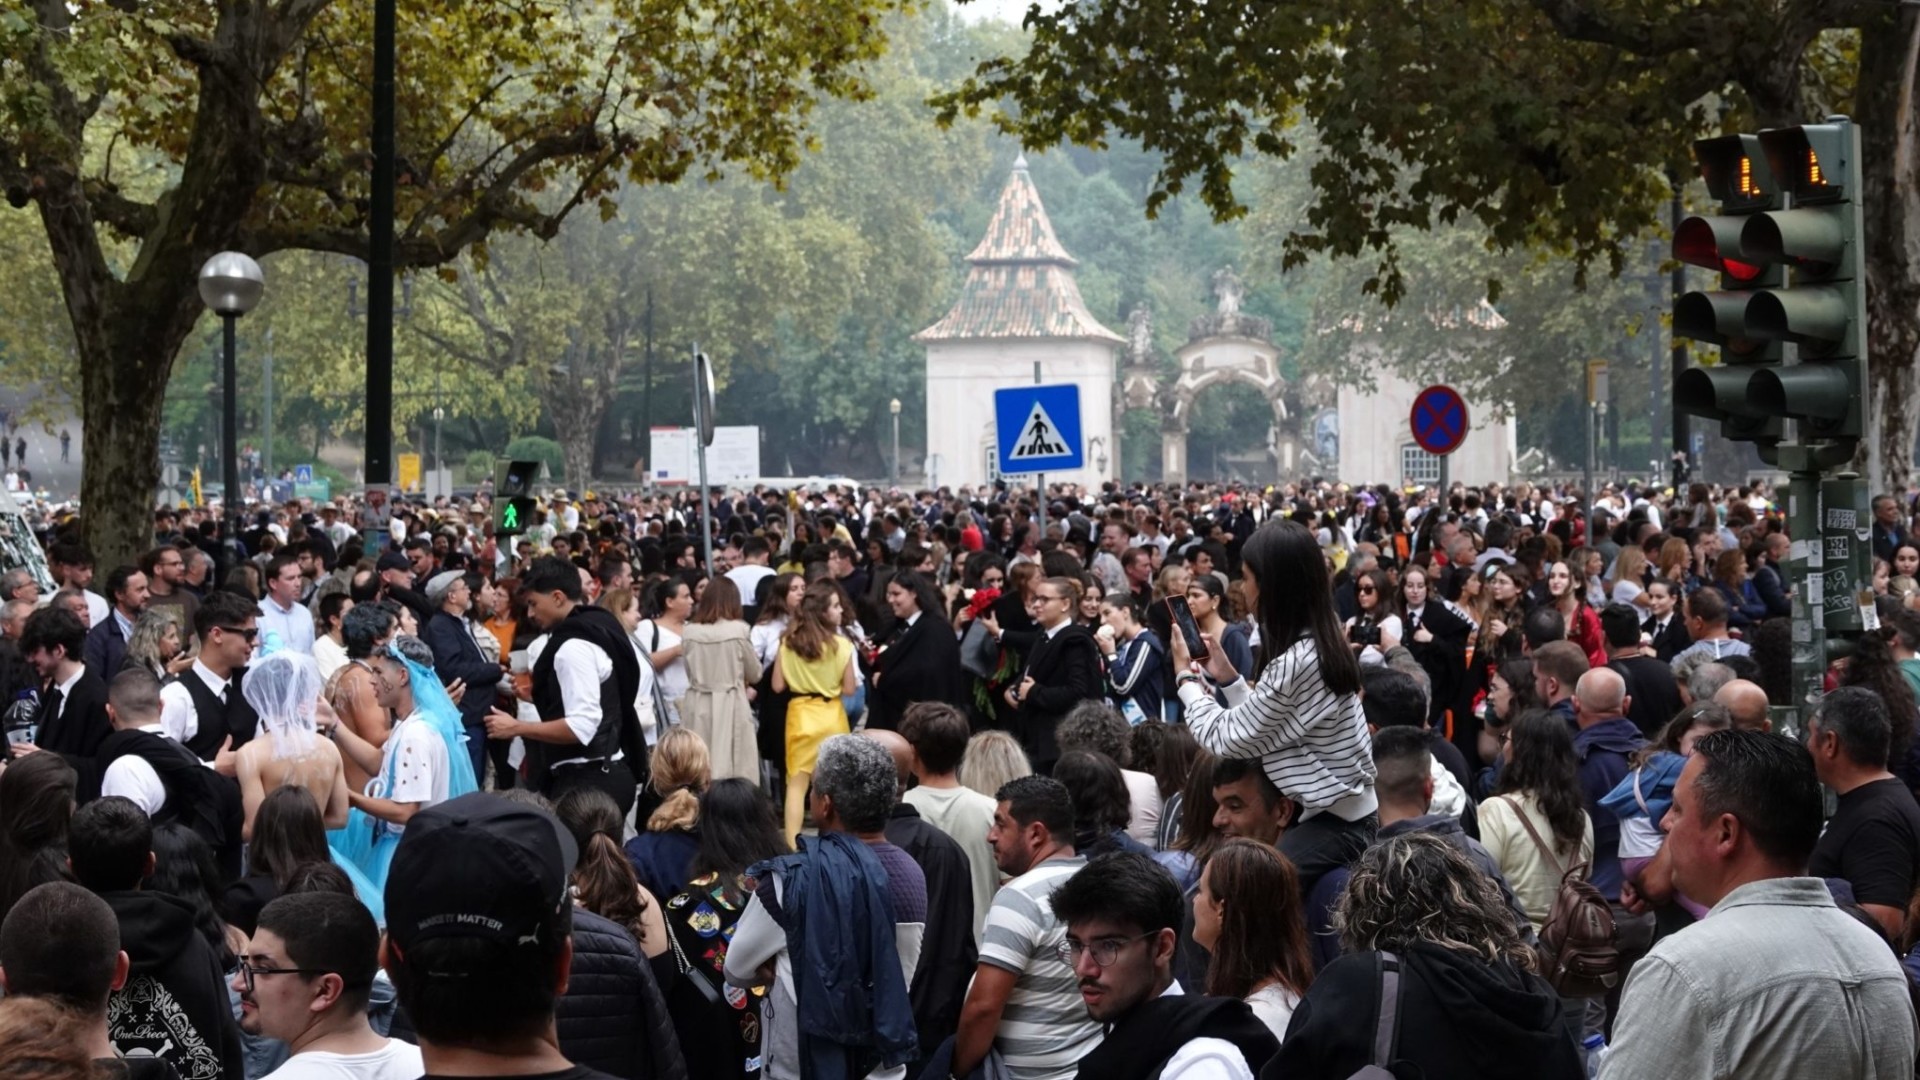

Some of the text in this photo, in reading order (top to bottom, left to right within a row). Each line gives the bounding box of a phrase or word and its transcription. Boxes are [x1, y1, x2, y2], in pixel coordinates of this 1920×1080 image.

[457, 913, 504, 931] MATTER
[113, 1023, 168, 1040] One Piece
